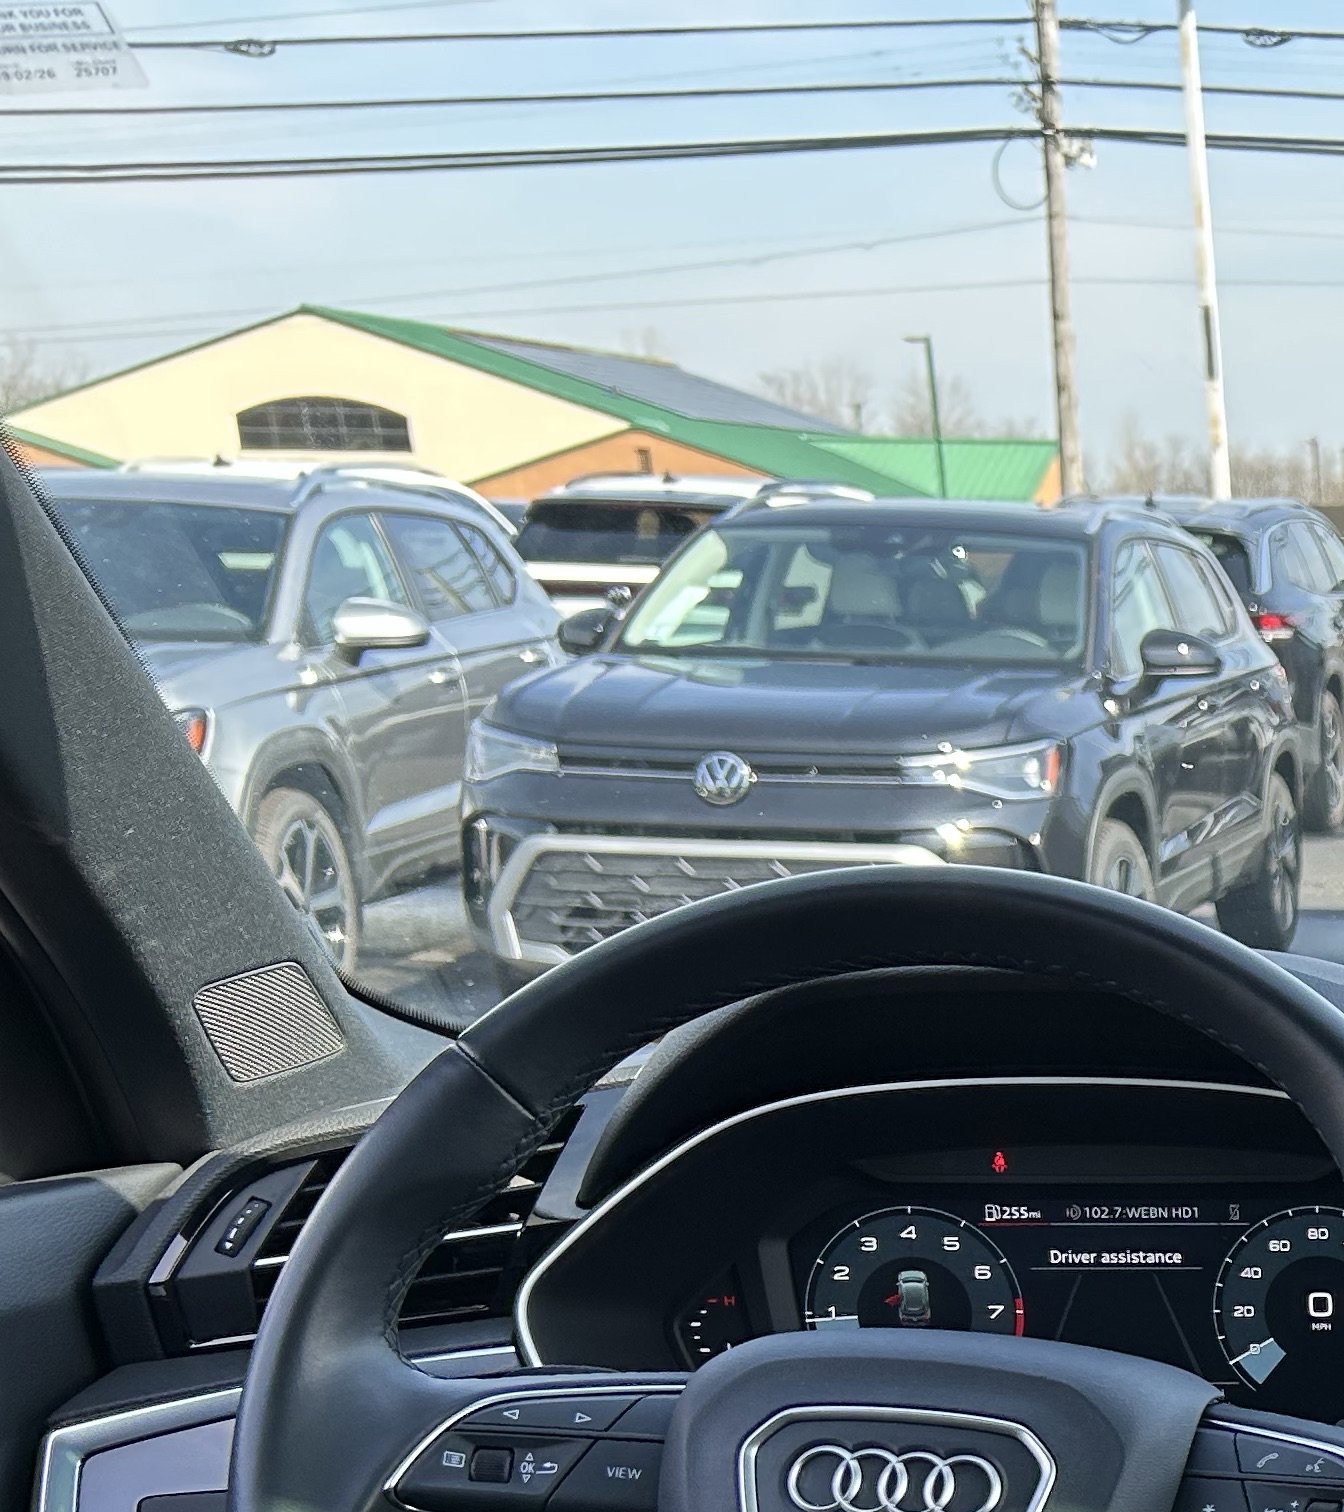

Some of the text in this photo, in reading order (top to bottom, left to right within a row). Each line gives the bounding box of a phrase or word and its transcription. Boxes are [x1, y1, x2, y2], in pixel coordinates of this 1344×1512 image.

[20, 9, 51, 19] YOU
[53, 8, 85, 17] FOR
[19, 21, 91, 32] BUSINESS
[29, 43, 60, 53] FOR
[62, 41, 120, 52] SERVICE
[1172, 1208, 1200, 1220] HD1
[900, 1225, 917, 1239] 4
[1307, 1228, 1329, 1240] 80
[860, 1236, 878, 1252] 3
[942, 1236, 960, 1251] 5
[1268, 1239, 1291, 1252] 60
[1049, 1249, 1183, 1265] Driver assistance
[832, 1265, 850, 1281] 2
[974, 1265, 992, 1280] 6
[1239, 1267, 1262, 1279] 40
[1233, 1305, 1255, 1318] 20
[1308, 1291, 1333, 1318] 0
[827, 1305, 837, 1319] 1
[987, 1304, 1005, 1320] 7
[1311, 1322, 1332, 1331] MPH
[520, 1461, 535, 1475] OK
[606, 1465, 643, 1480] VIEW
